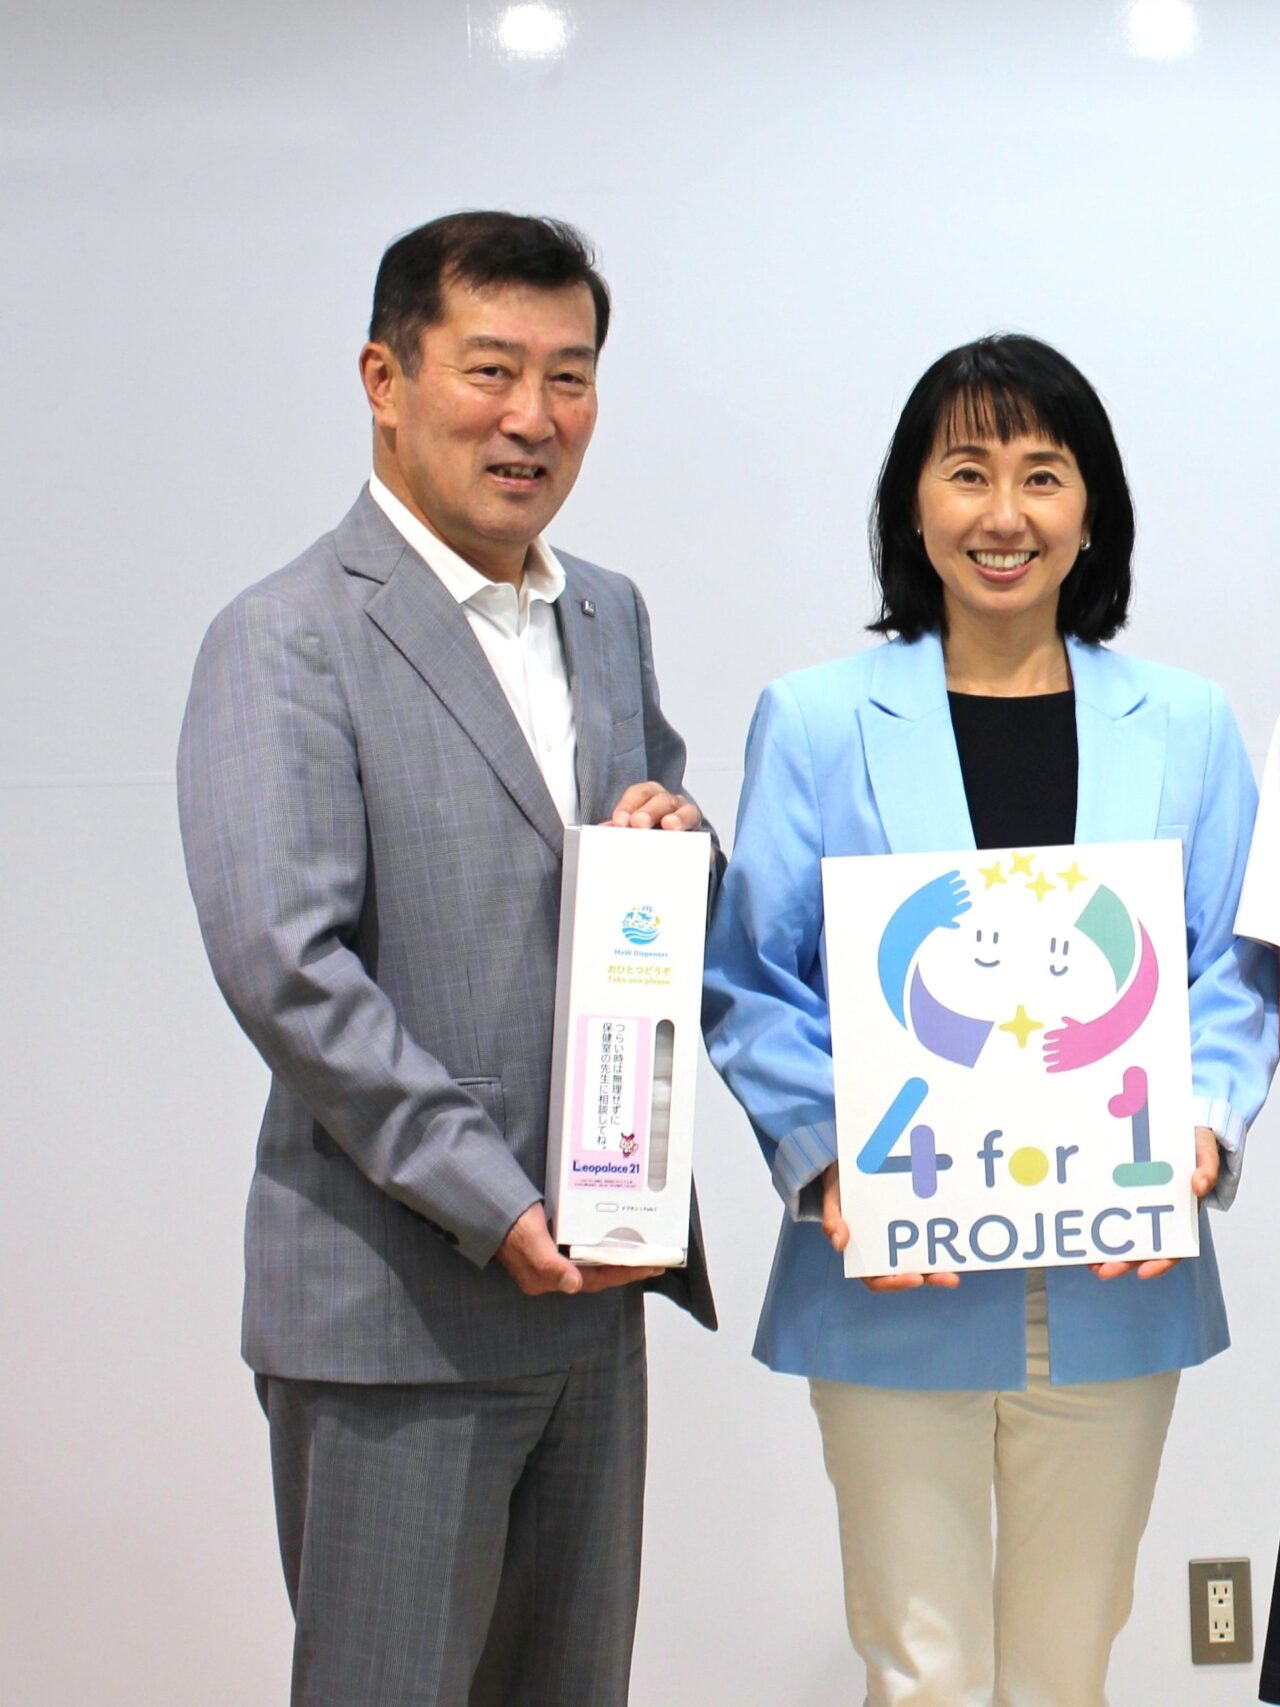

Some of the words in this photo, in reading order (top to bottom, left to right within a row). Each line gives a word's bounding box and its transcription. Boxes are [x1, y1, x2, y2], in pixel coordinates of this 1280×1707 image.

[608, 965, 672, 976] おひとつどうぞ
[645, 978, 670, 986] please
[597, 1022, 612, 1150] 保健室の先生に相談してね。
[611, 1023, 626, 1125] つらい時は無理せずに
[857, 1077, 953, 1199] 4
[977, 1129, 1079, 1187] for
[1108, 1066, 1174, 1187] 1
[573, 1160, 628, 1175] Leopalace
[629, 1163, 640, 1174] 21
[888, 1204, 1175, 1267] PROJECT
